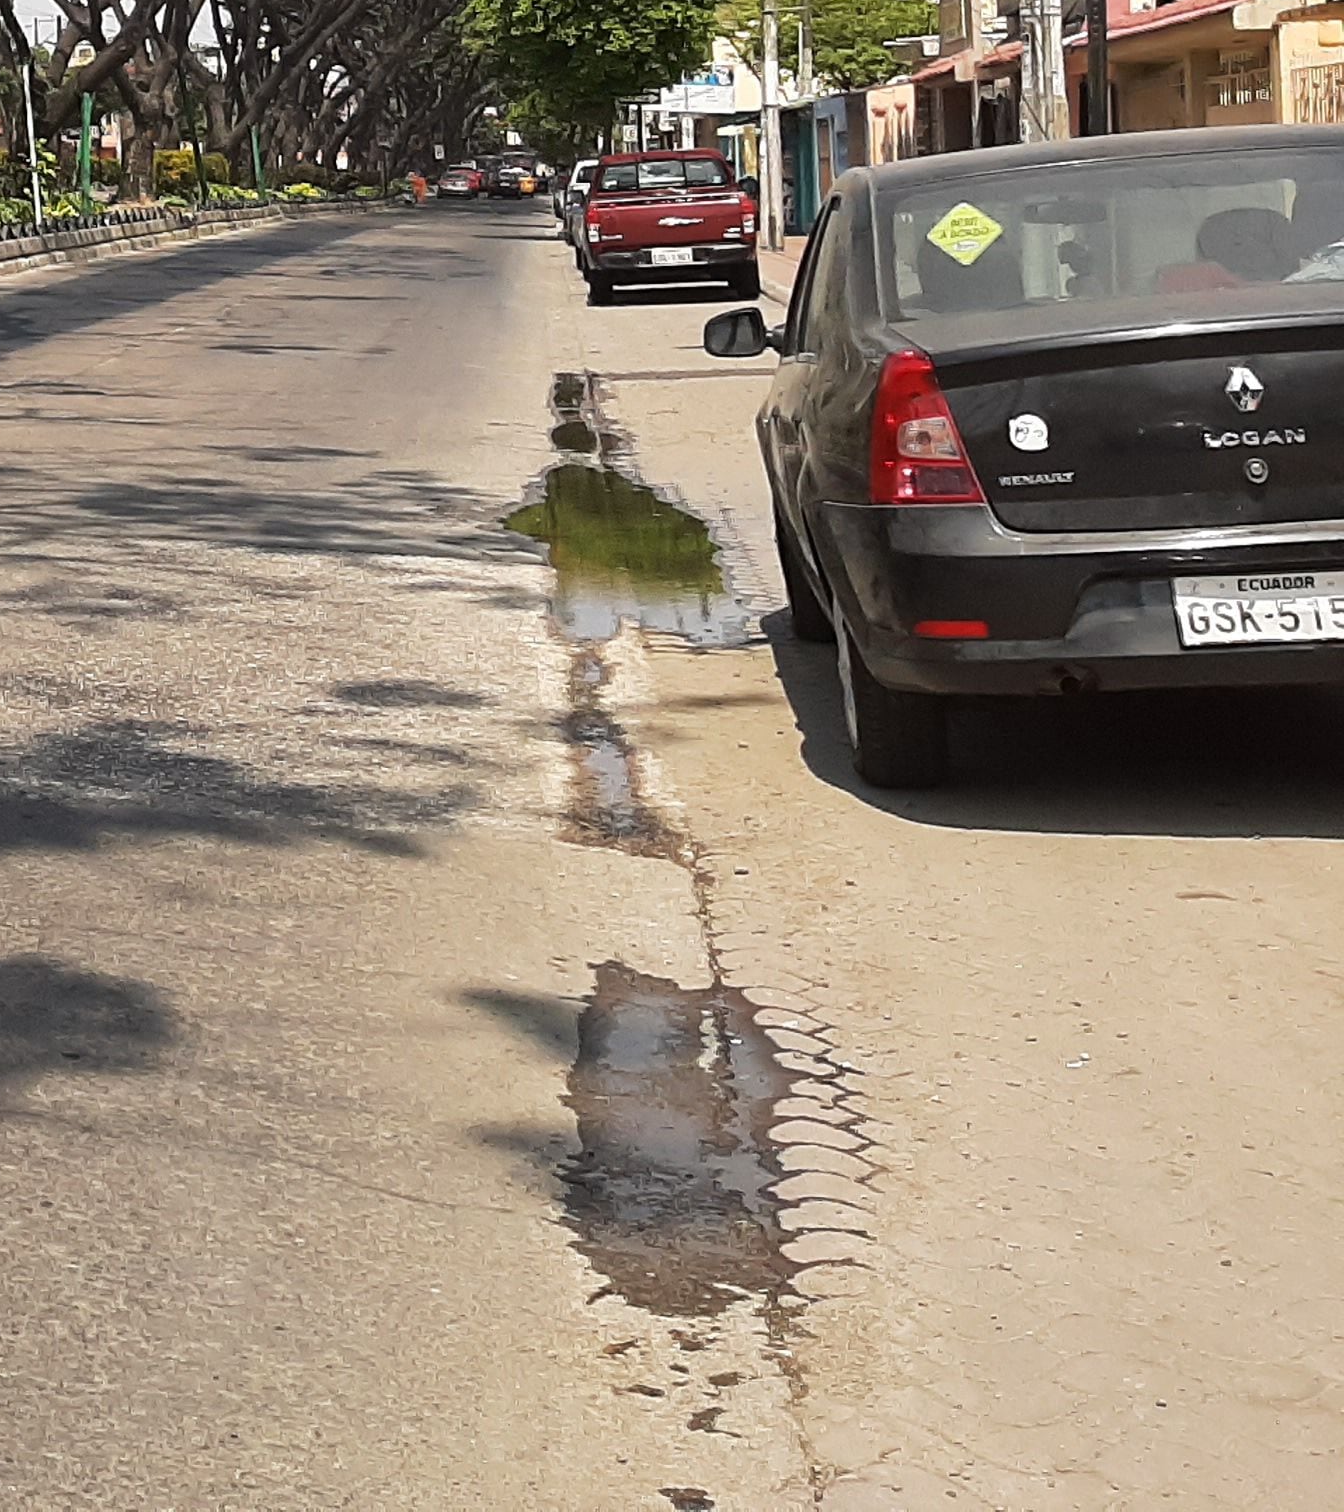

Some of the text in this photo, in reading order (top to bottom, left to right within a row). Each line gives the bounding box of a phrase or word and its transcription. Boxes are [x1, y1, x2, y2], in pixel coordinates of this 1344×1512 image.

[1202, 428, 1307, 448] LOGAN
[998, 472, 1075, 487] RENAULT
[1237, 576, 1316, 592] ECUADOR
